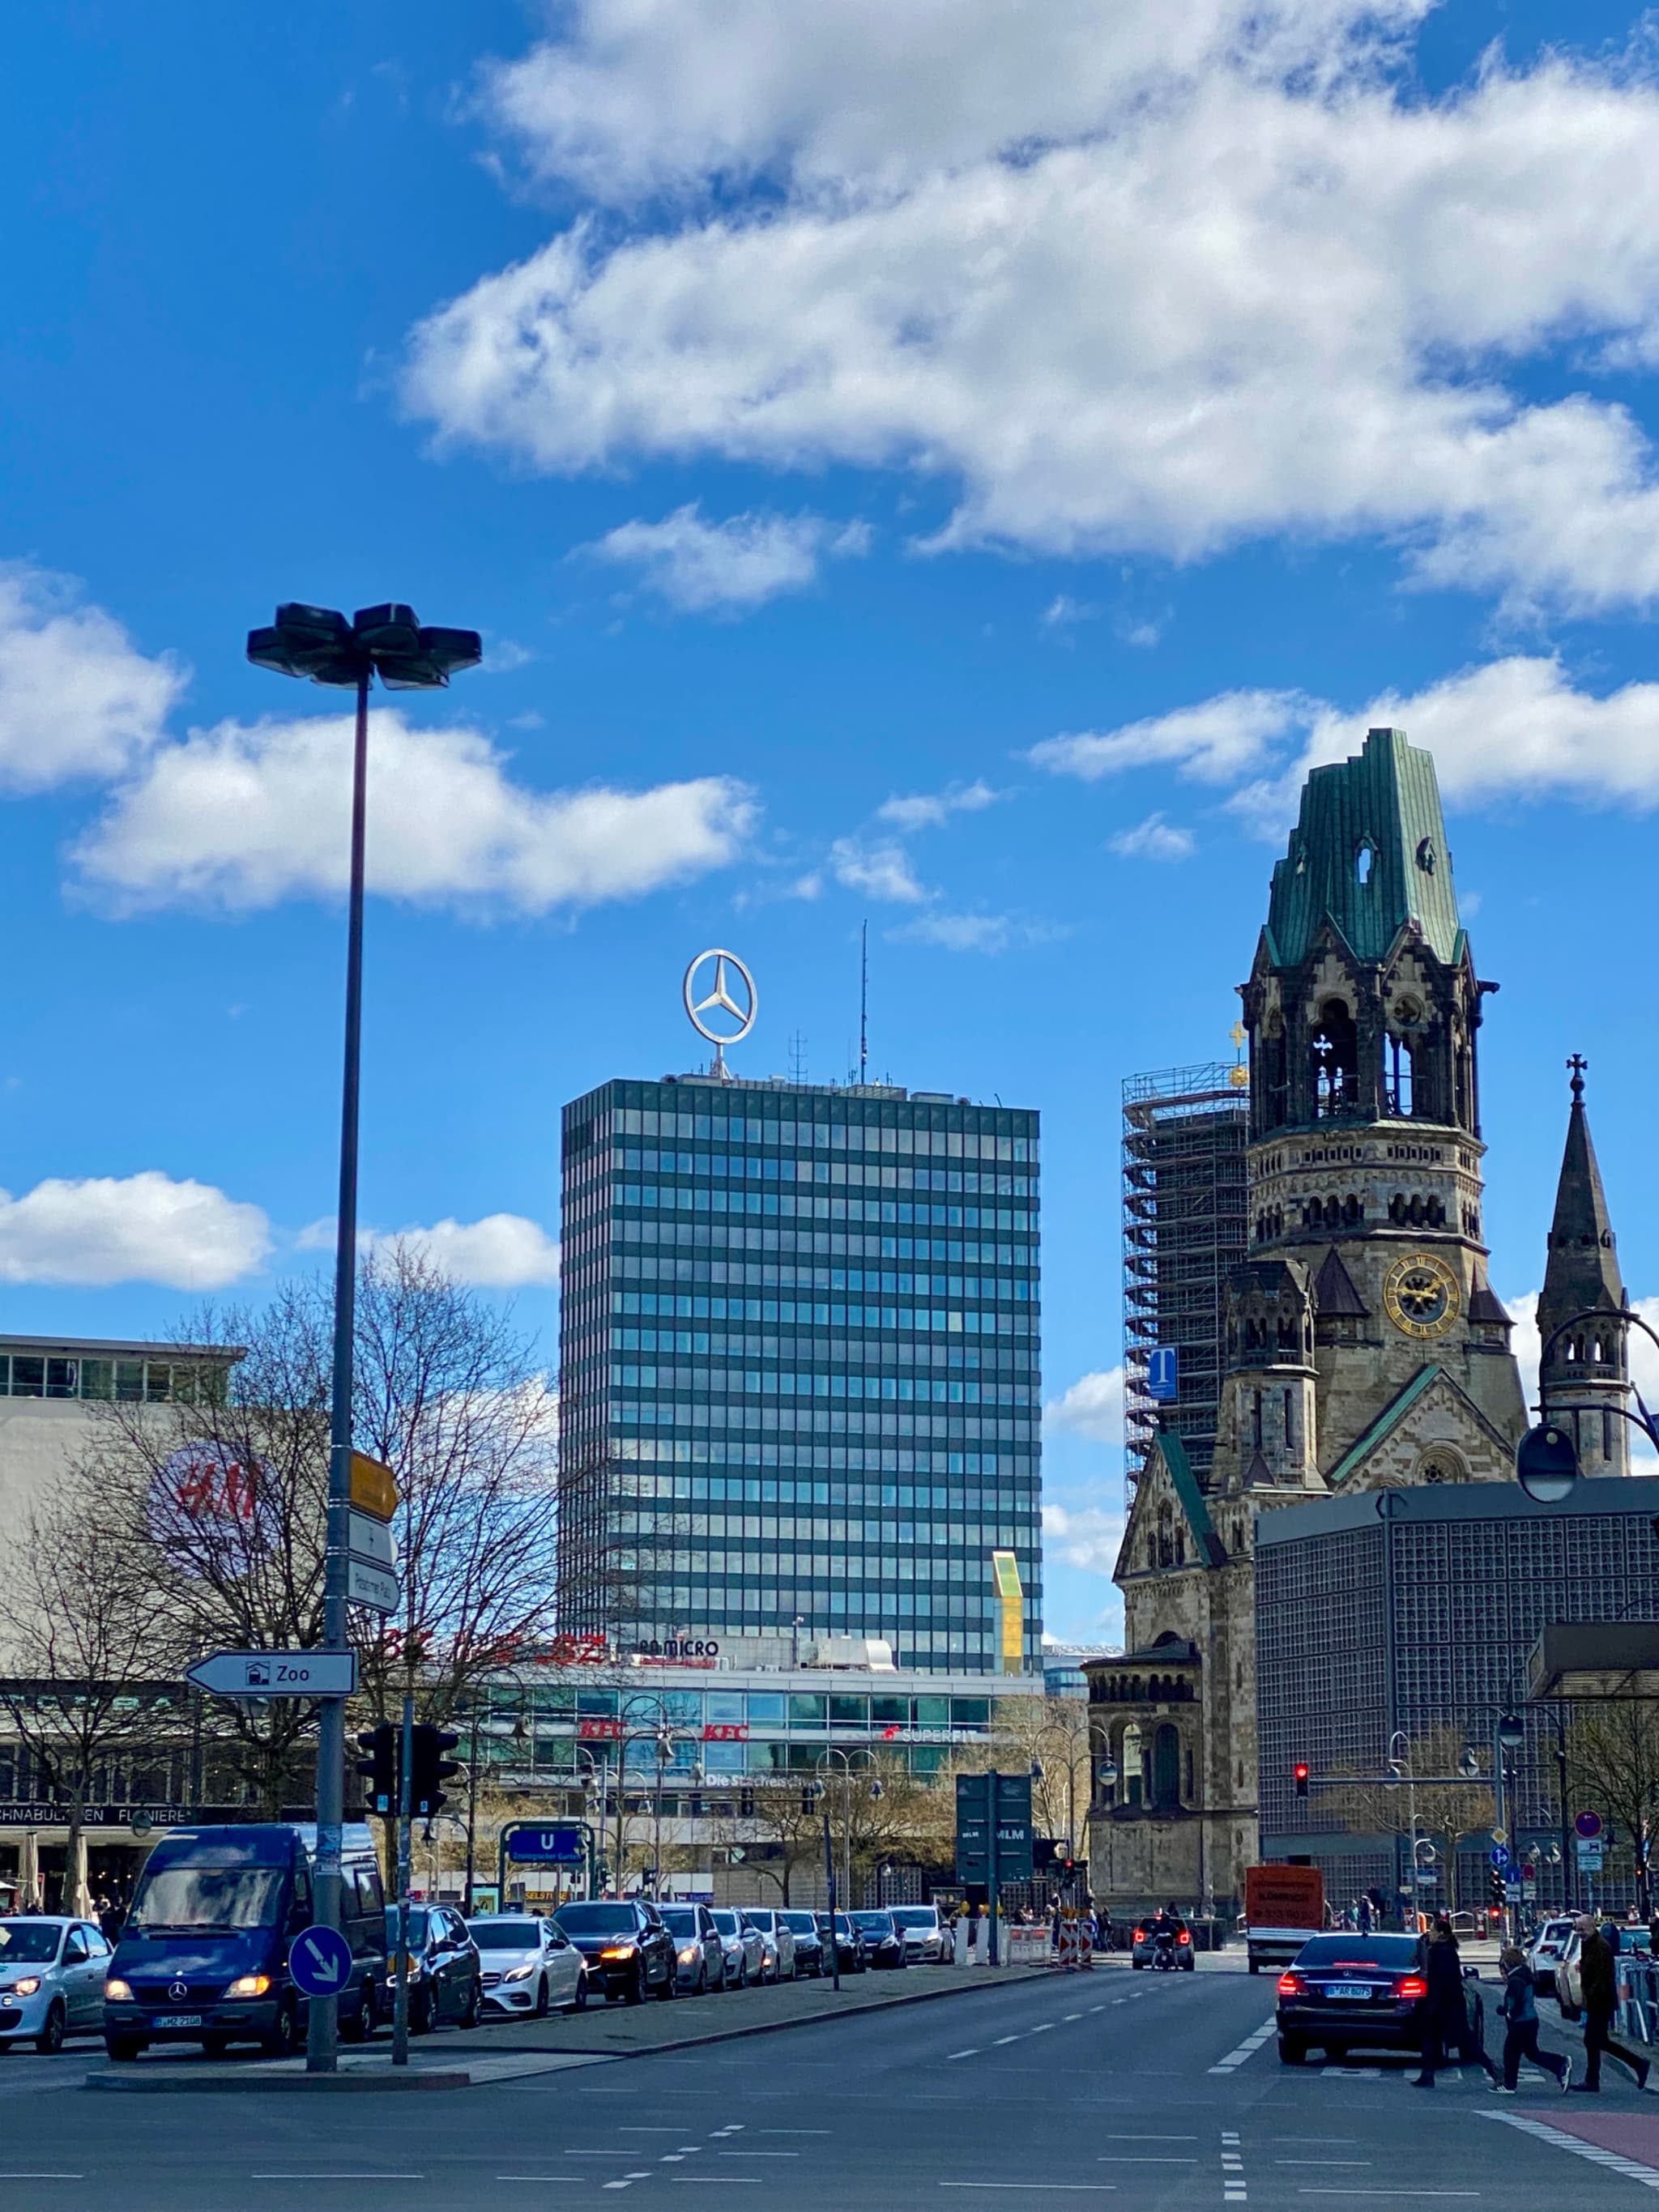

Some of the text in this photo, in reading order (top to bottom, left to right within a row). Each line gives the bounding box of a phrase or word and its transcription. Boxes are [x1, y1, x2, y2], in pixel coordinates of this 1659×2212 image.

[1150, 1348, 1175, 1383] T
[276, 1664, 309, 1681] Zoo
[578, 1721, 626, 1739] KFC
[703, 1724, 749, 1741] KFC
[902, 1728, 977, 1743] SUPERFIT
[706, 1774, 727, 1787] Die
[541, 1834, 554, 1850] U
